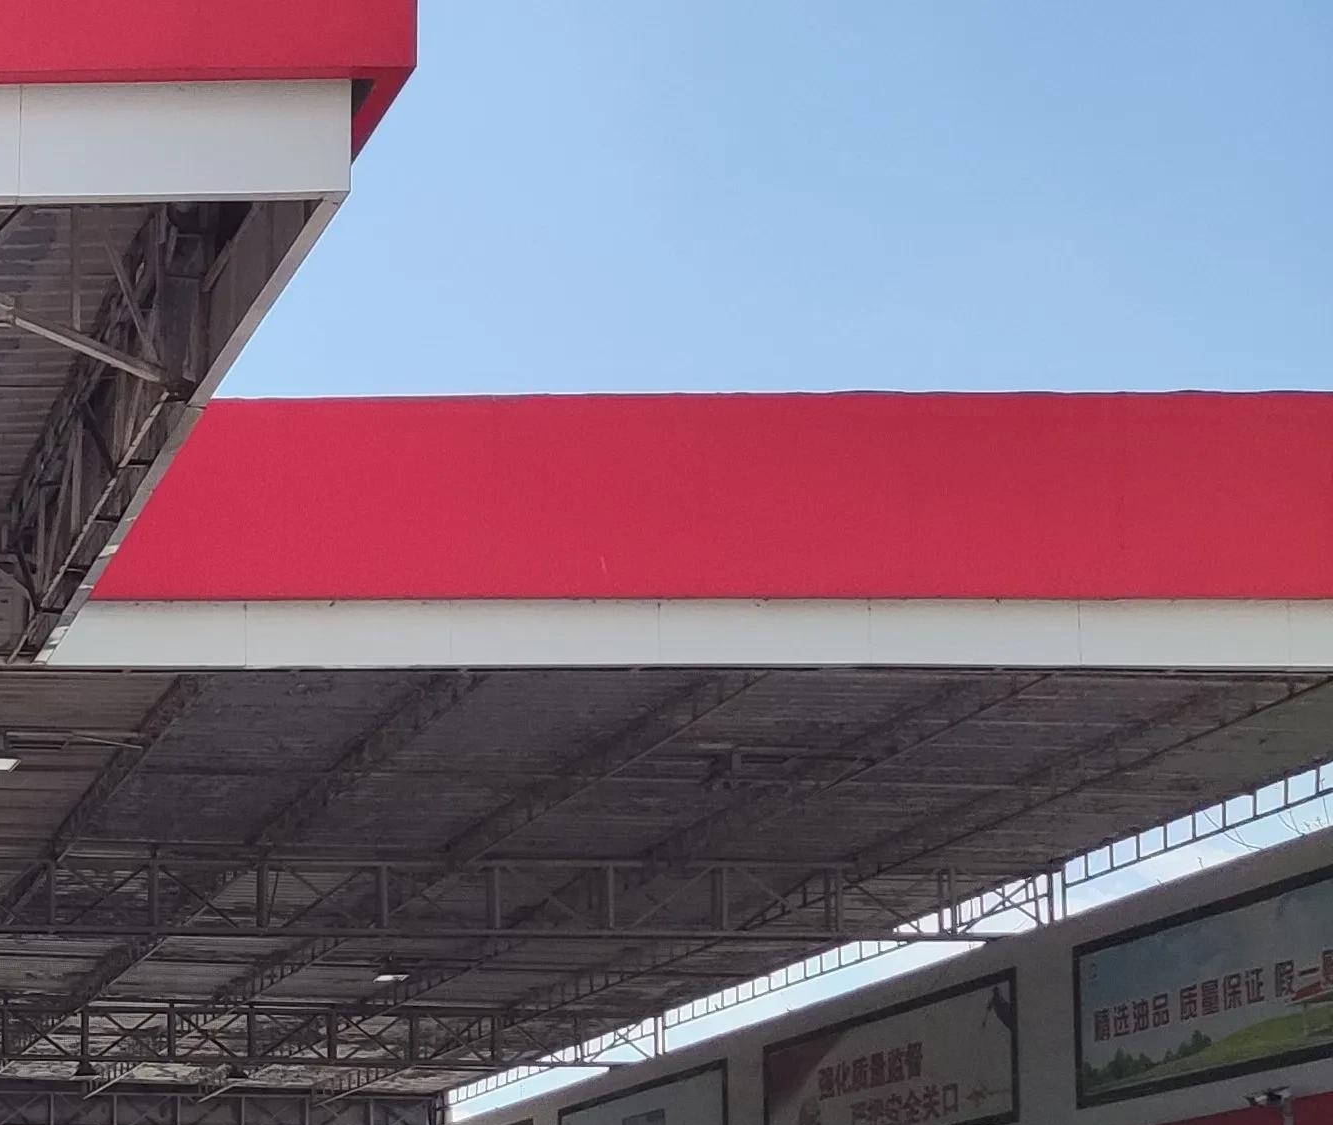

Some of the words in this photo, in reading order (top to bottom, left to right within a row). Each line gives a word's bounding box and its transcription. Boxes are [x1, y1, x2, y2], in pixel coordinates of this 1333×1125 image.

[1094, 992, 1170, 1042] 精选油品
[1179, 967, 1265, 1021] 质量保证
[818, 1041, 923, 1101] 强化质量监督
